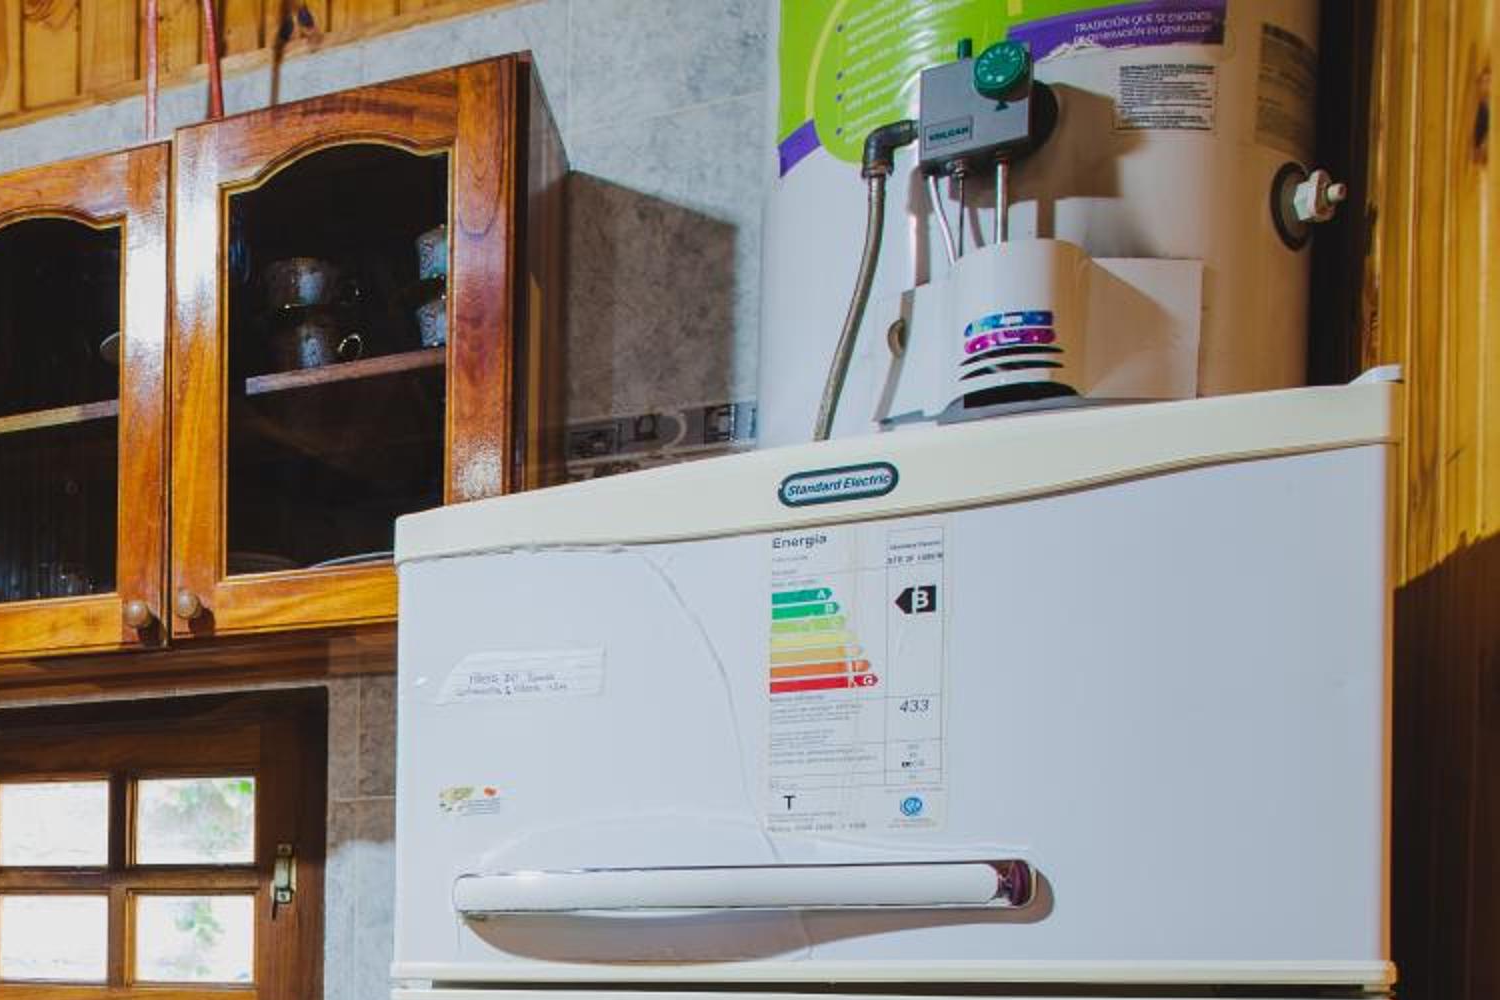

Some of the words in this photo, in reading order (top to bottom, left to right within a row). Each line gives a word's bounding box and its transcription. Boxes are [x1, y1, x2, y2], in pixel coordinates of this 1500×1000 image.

[1131, 14, 1153, 27] QUE
[787, 478, 842, 497] Standard
[843, 473, 891, 490] Electric
[817, 590, 826, 599] A
[911, 588, 930, 612] B
[899, 699, 929, 713] 433
[783, 795, 796, 810] T
